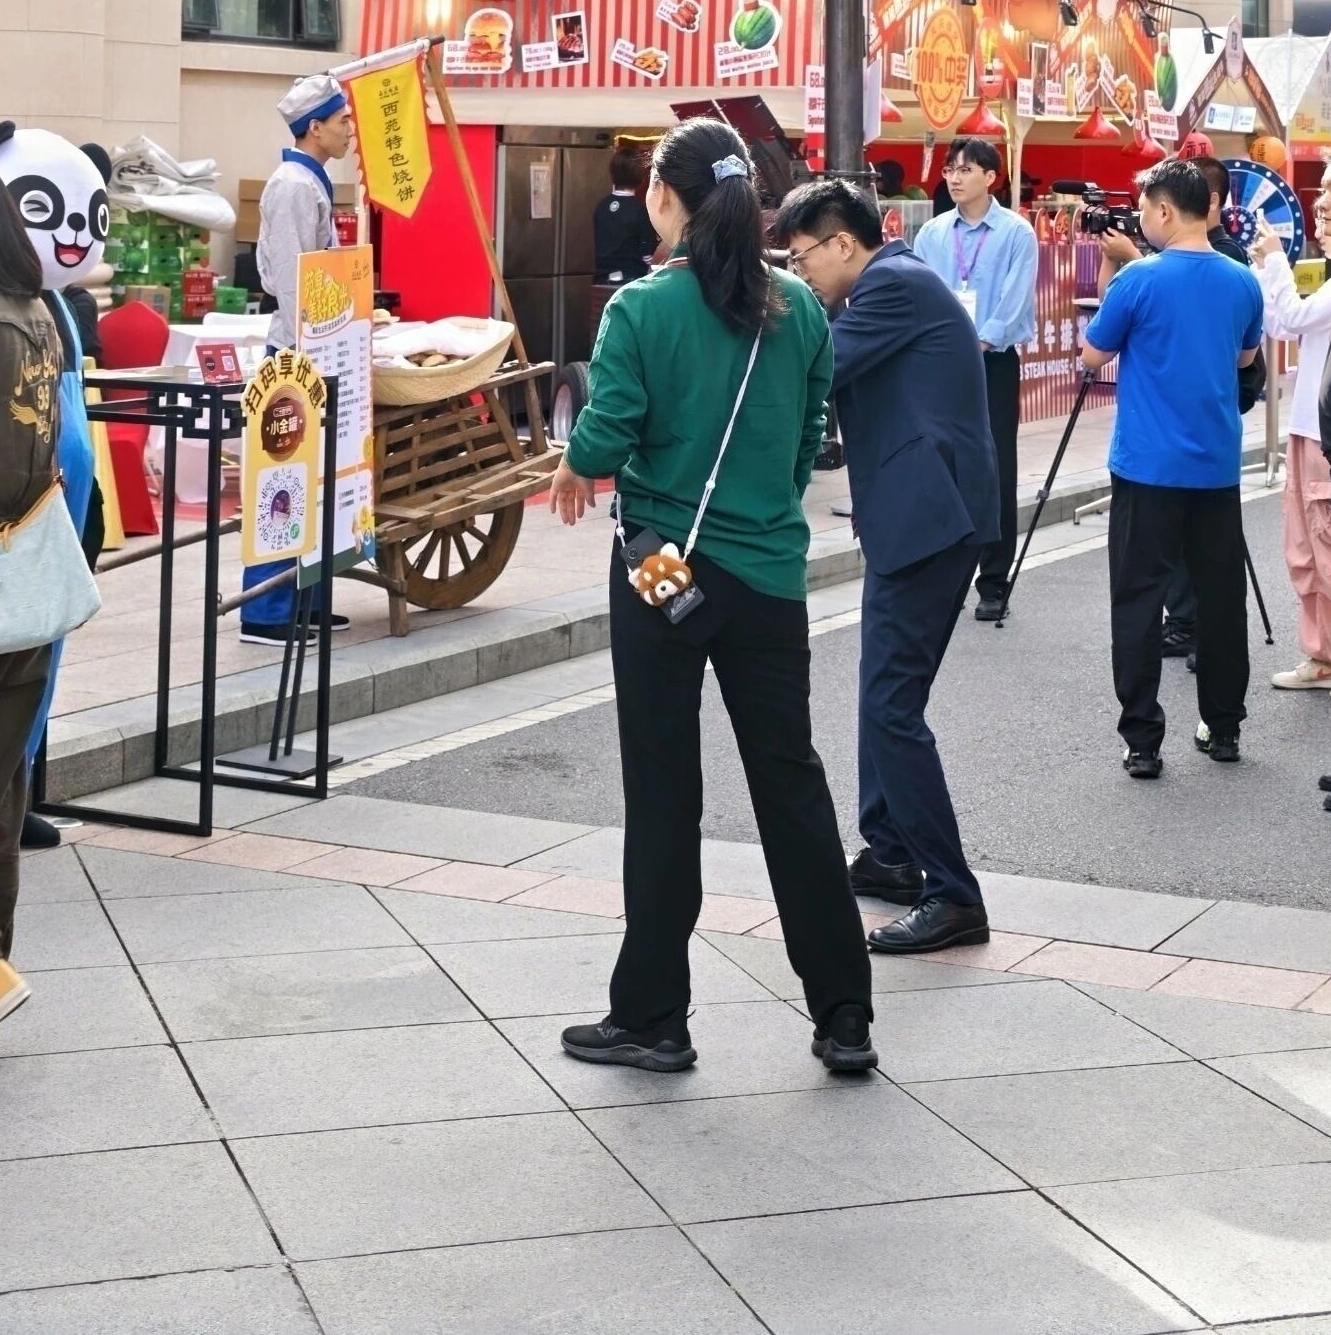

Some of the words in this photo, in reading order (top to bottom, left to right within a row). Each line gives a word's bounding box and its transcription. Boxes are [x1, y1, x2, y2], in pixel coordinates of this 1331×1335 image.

[381, 100, 415, 203] 西苑特色烧饼
[245, 352, 326, 416] 扫码享优惠
